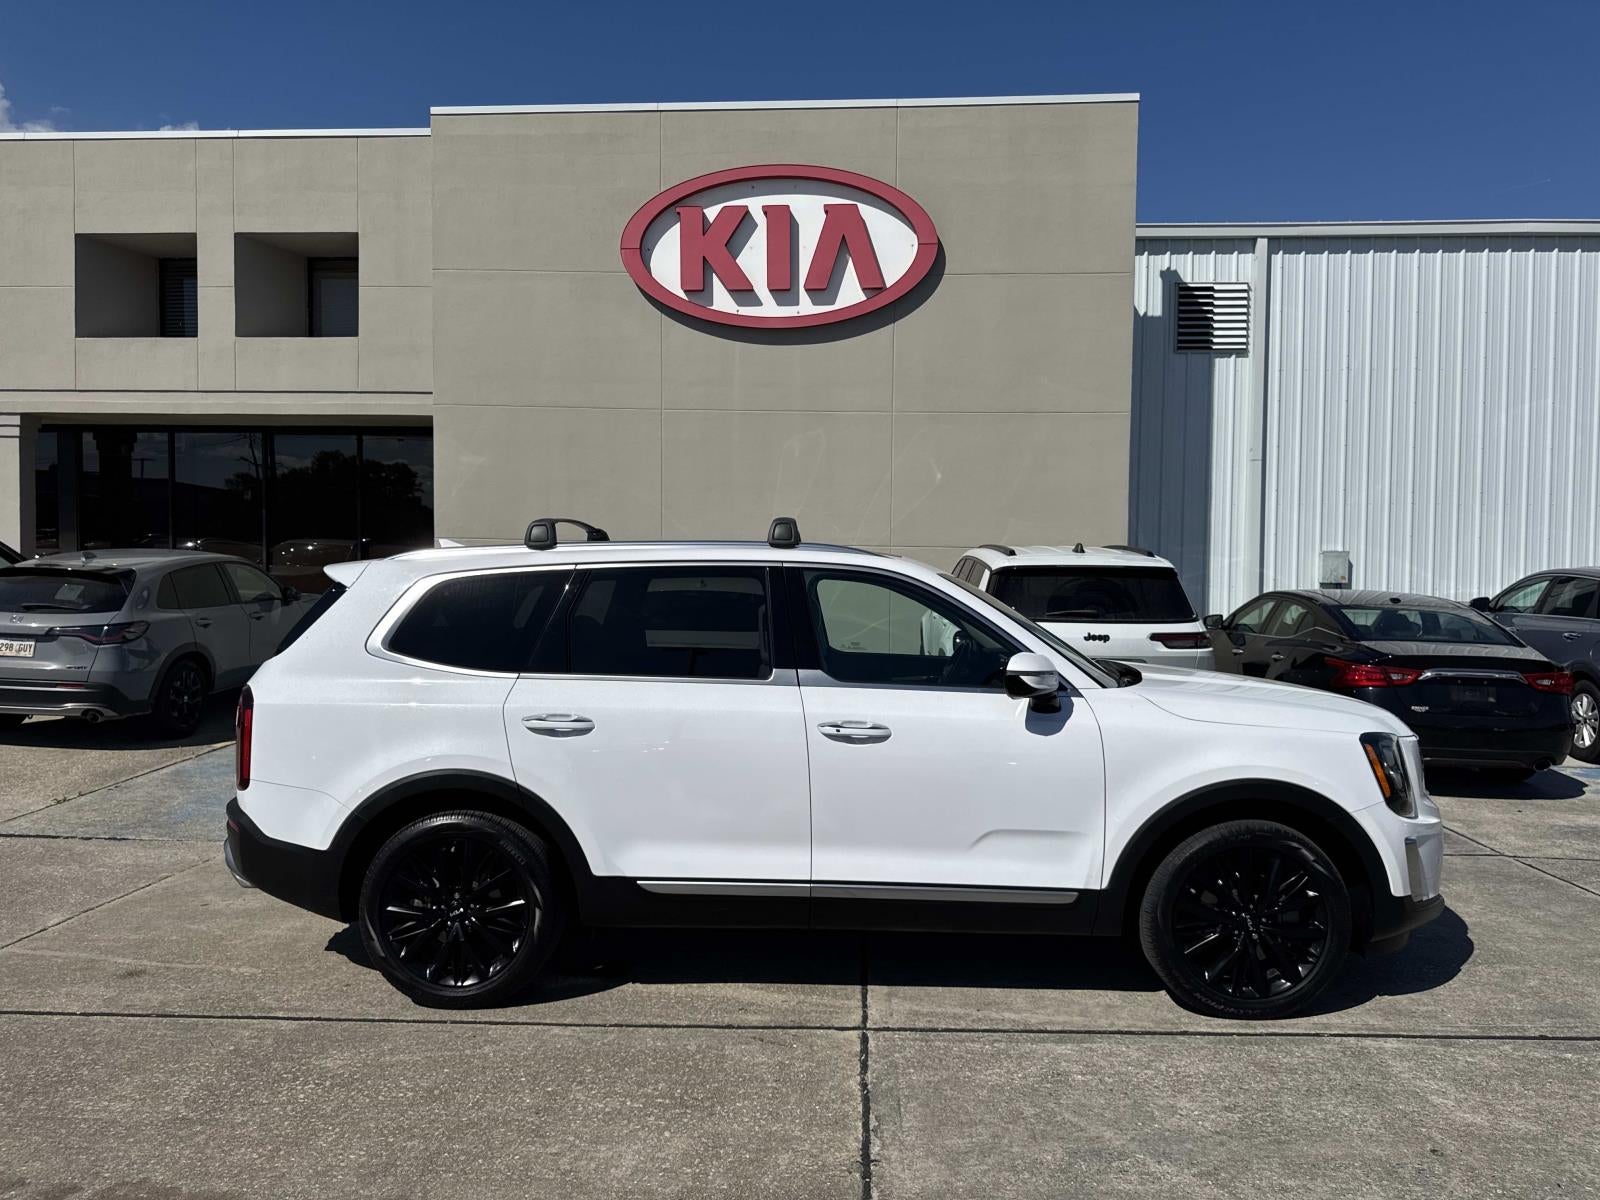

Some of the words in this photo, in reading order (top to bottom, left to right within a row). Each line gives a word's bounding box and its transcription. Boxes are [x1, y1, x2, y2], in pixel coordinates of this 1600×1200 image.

[676, 204, 885, 291] KIA
[1083, 632, 1110, 643] Jeep
[18, 643, 33, 653] GUY
